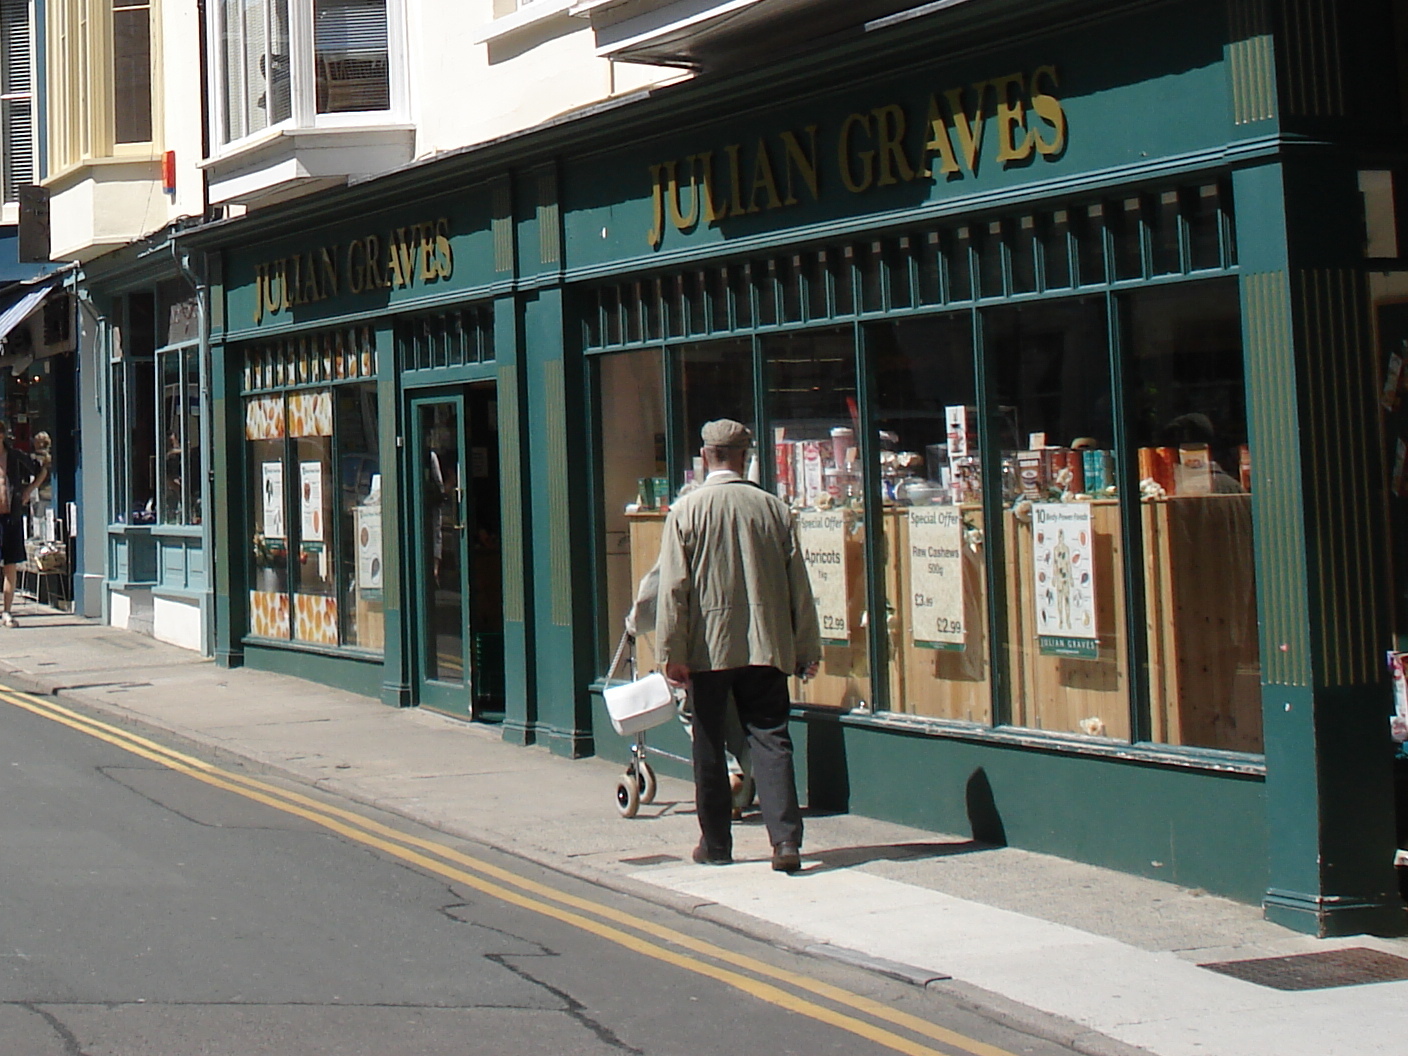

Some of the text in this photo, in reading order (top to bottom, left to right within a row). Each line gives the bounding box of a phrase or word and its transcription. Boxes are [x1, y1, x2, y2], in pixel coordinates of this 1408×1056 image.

[648, 65, 1066, 247] JULIAN GRAVES
[254, 218, 453, 324] JULIAN GRAVES
[801, 516, 842, 531] Special Offer
[911, 511, 959, 527] Special Offer
[1035, 509, 1046, 524] 10
[805, 549, 841, 567] Apricots
[928, 546, 960, 558] Cashews
[823, 615, 845, 630] £2.99
[937, 617, 962, 633] £2.99
[1040, 638, 1095, 650] JULIAN GRAVES
